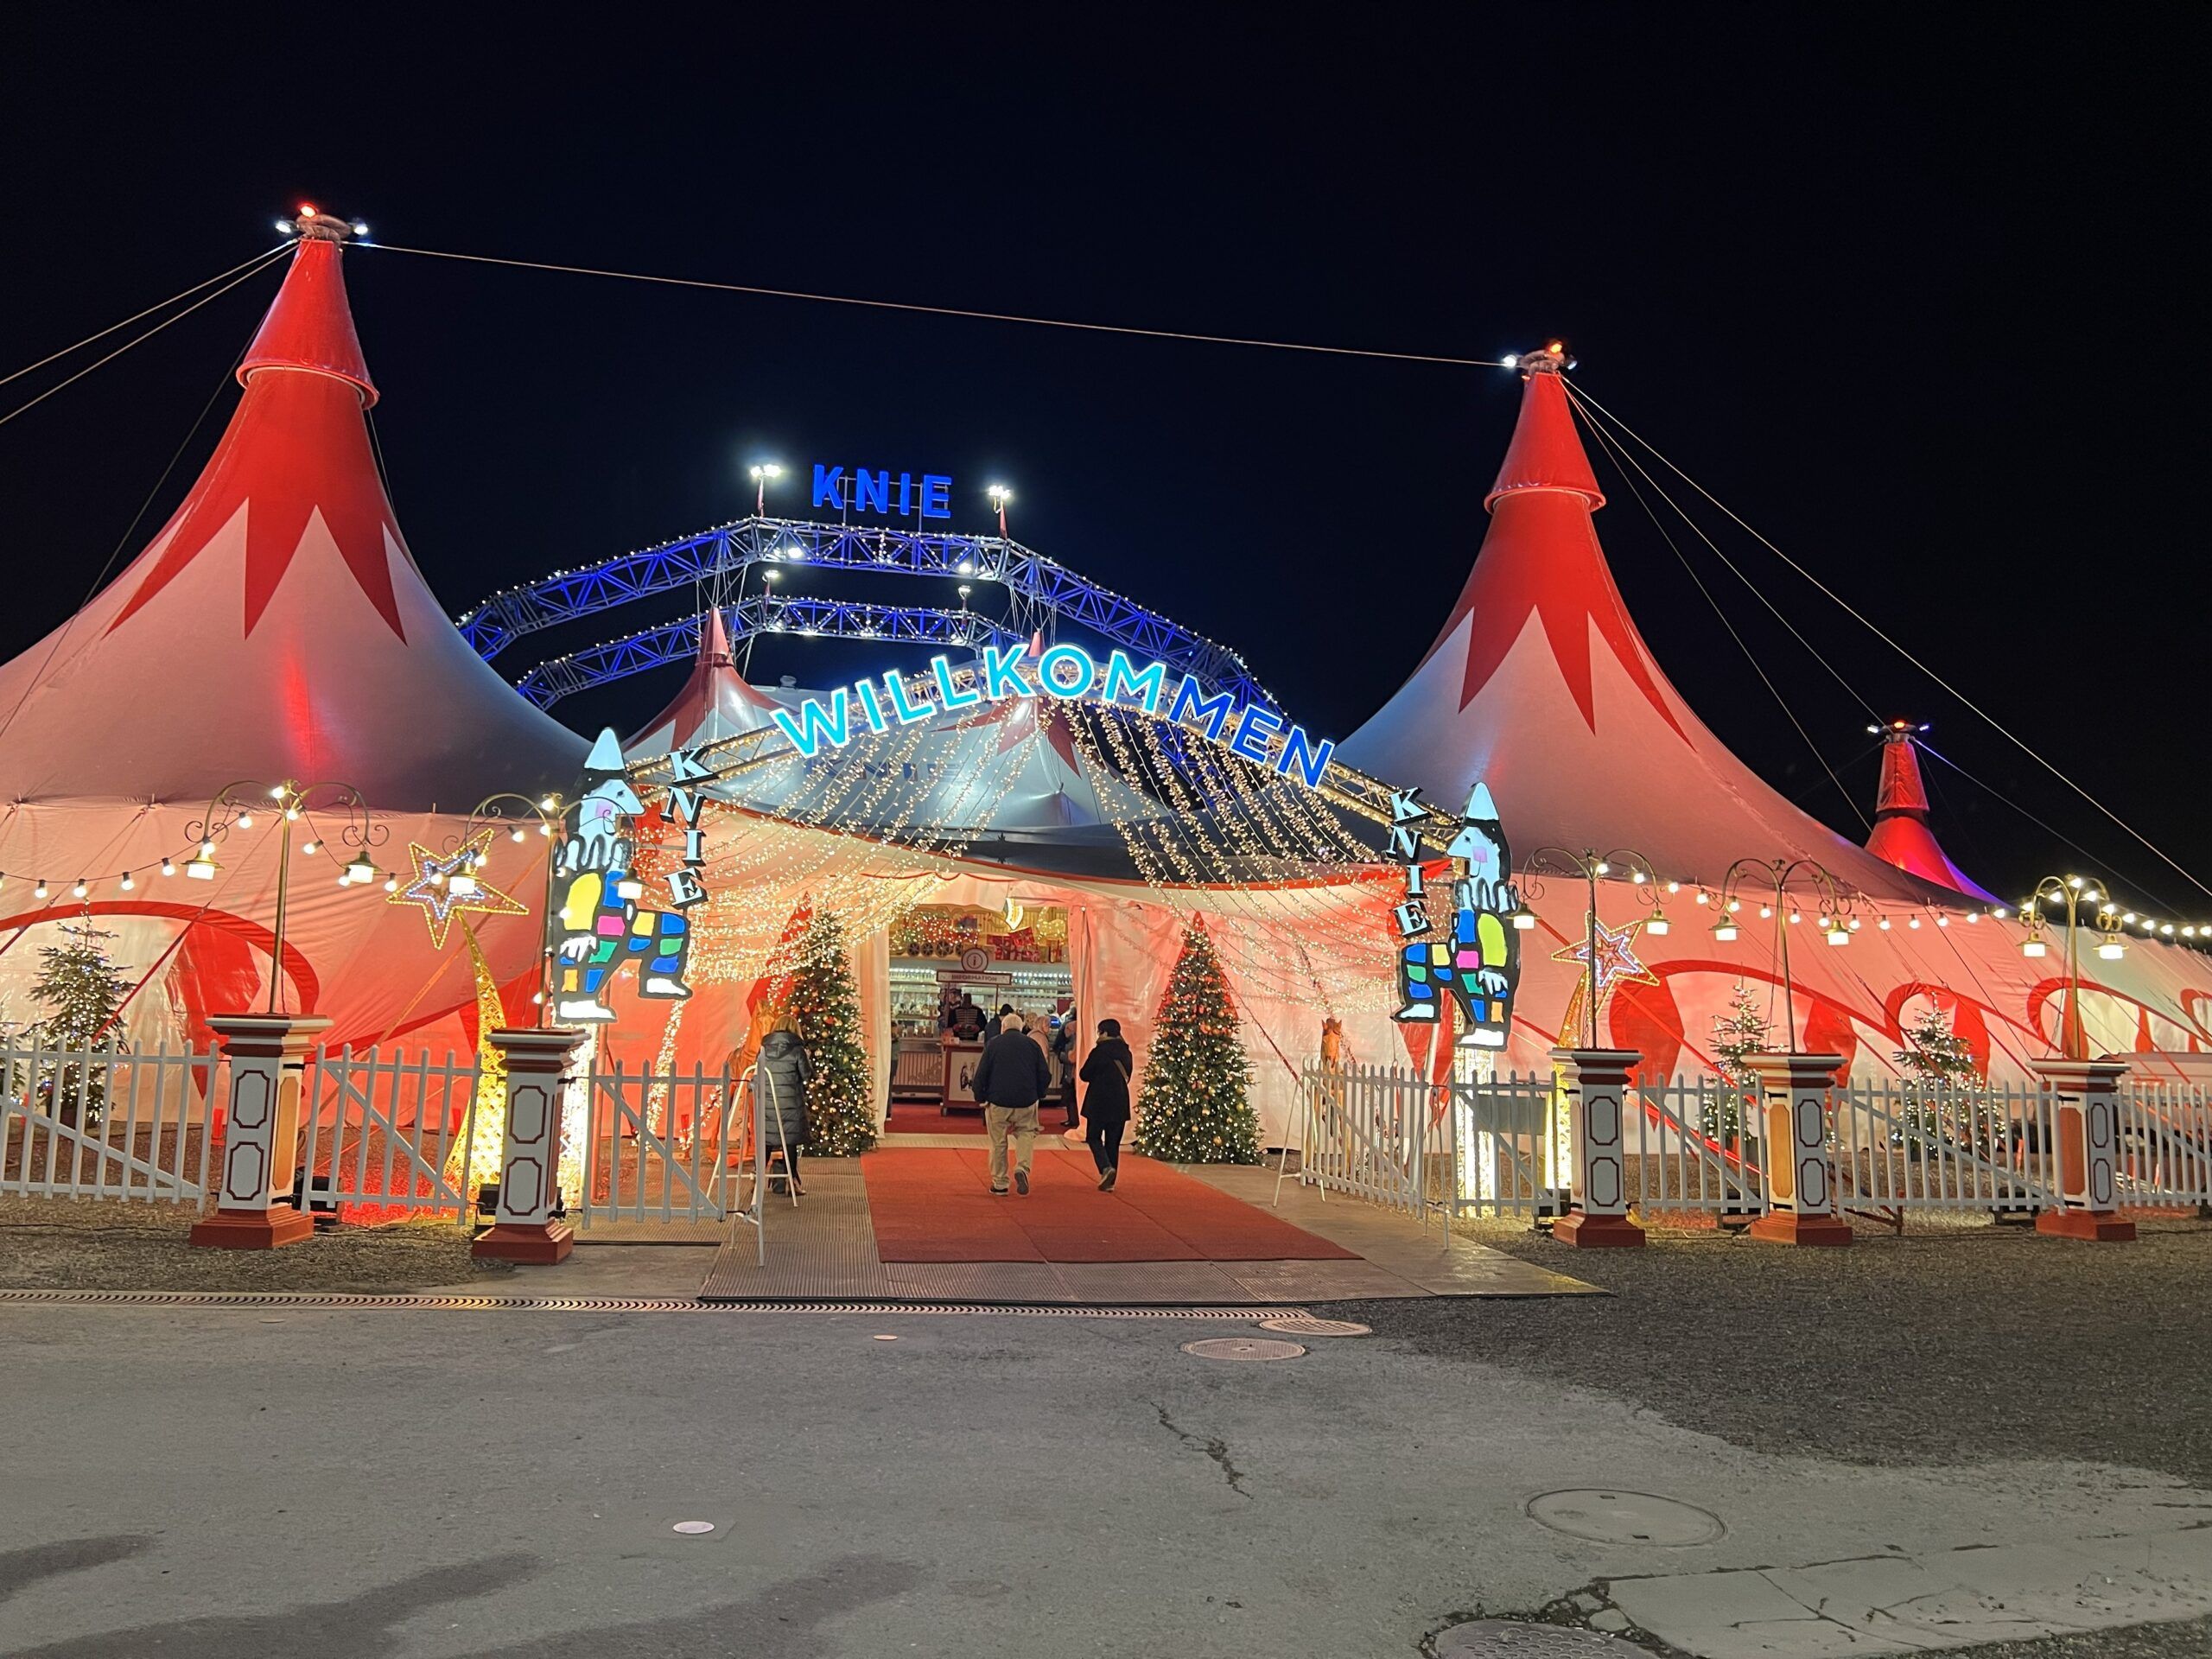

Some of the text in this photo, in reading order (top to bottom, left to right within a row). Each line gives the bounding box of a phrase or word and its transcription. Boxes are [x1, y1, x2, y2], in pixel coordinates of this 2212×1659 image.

[813, 464, 952, 518] KNIE
[773, 643, 1335, 788] WILLKOMMEN
[660, 747, 717, 906] KNIE
[1384, 787, 1431, 938] KNIE
